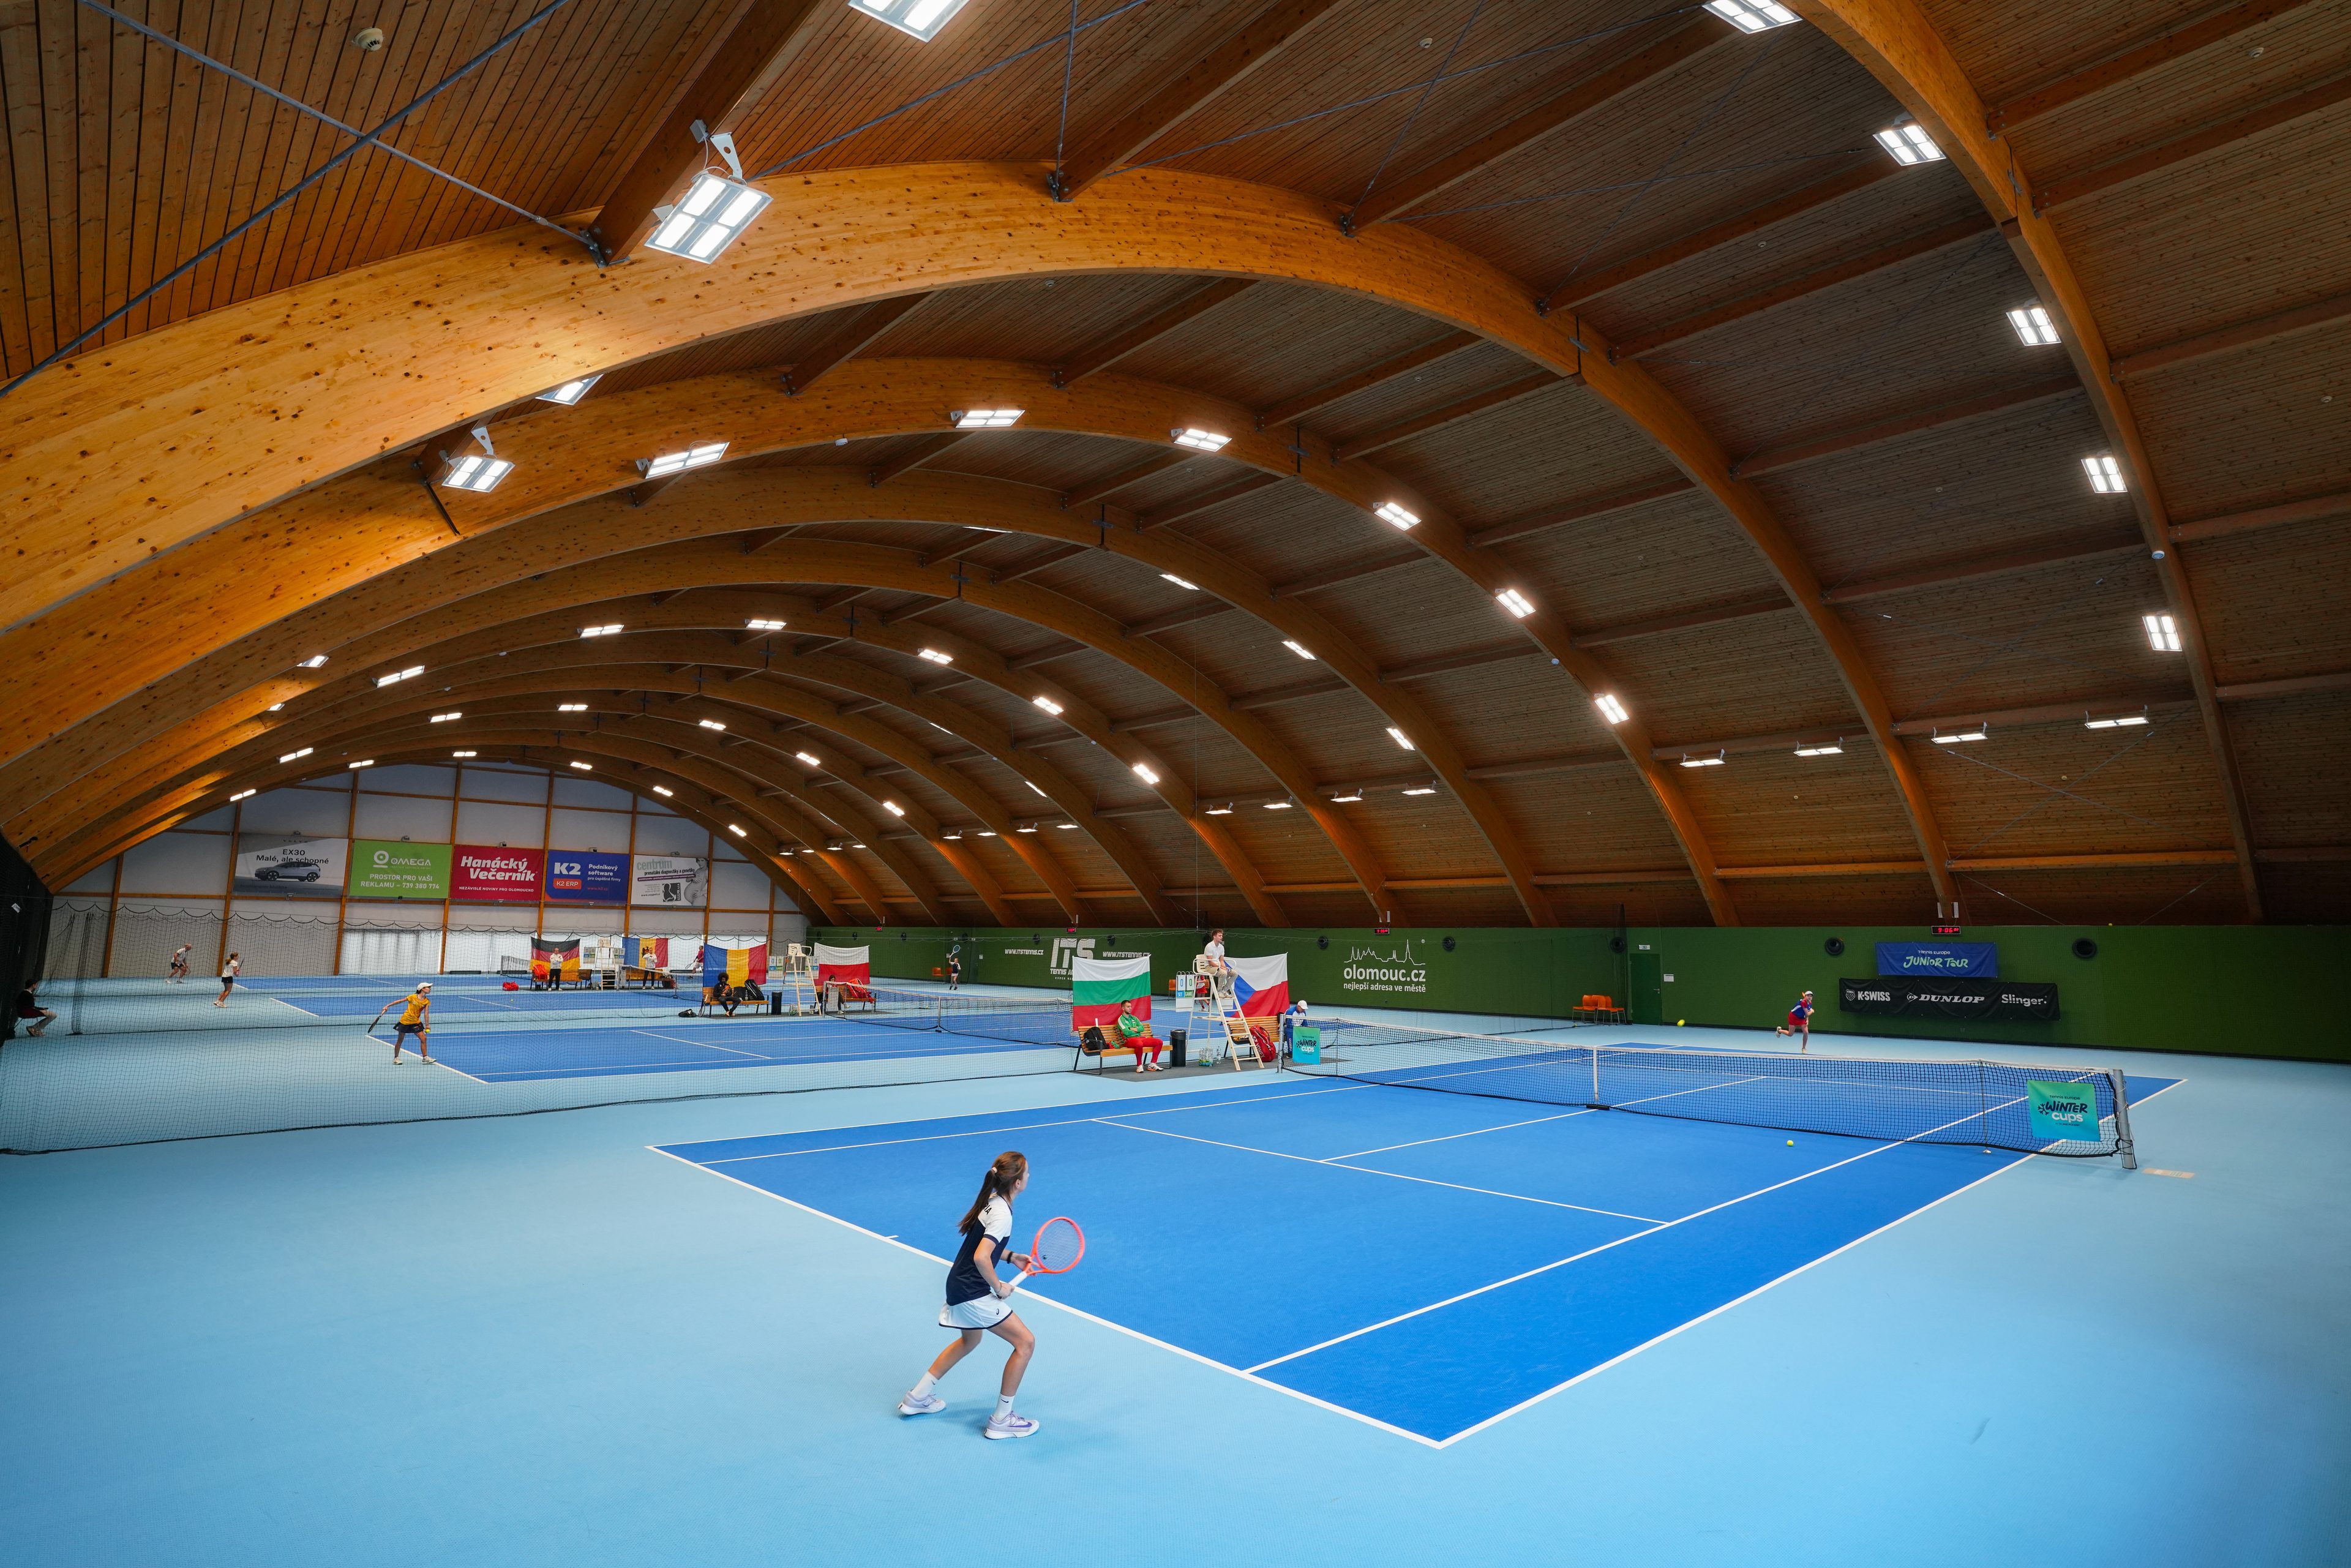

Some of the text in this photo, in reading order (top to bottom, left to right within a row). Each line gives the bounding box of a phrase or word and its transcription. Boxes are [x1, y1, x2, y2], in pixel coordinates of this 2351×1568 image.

[391, 858, 431, 866] OMEGA
[460, 856, 528, 872] Hanácký
[637, 858, 672, 870] centrum
[470, 868, 535, 881] Večerník
[553, 862, 581, 875] K2
[1050, 938, 1096, 968] ITS
[1343, 964, 1426, 982] olomouc.cz
[1343, 982, 1369, 991] nejlepší
[1370, 983, 1392, 991] adresa
[1918, 994, 1985, 1003] DUNLOP
[2052, 1112, 2083, 1123] cups
